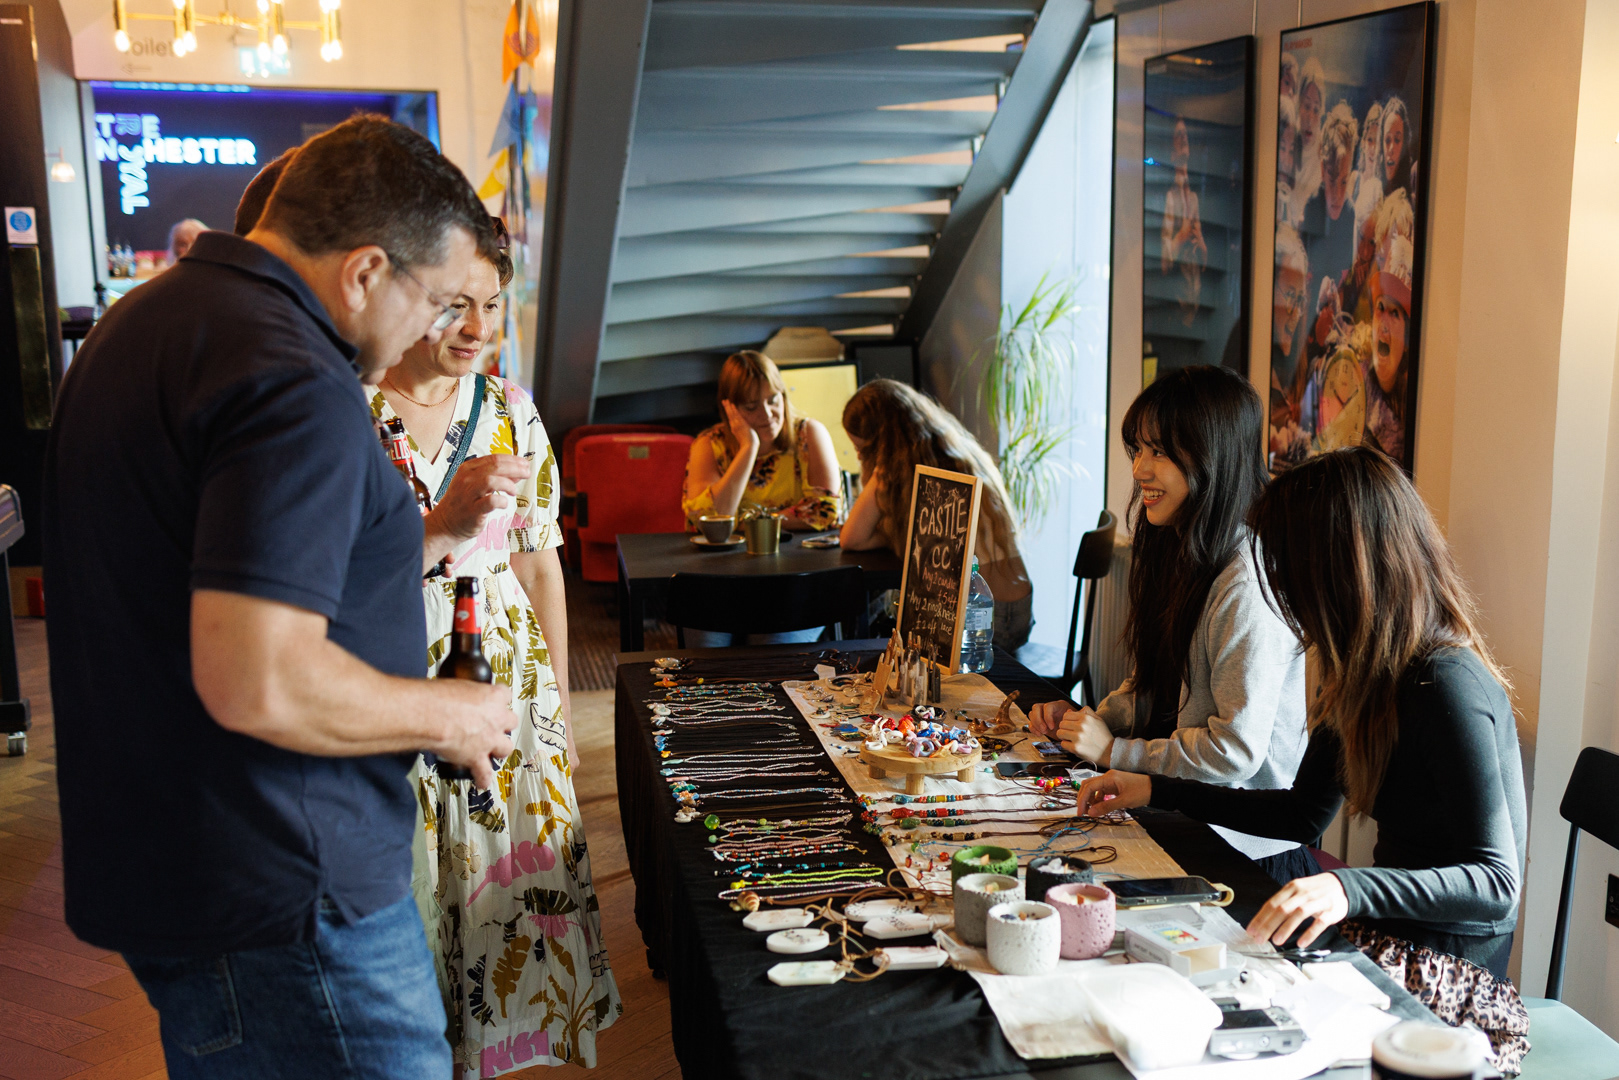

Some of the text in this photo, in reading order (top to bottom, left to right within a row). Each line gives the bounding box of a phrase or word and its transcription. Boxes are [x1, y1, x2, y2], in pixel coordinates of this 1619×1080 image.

[919, 498, 967, 539] CASTLE
[932, 545, 951, 570] CC
[909, 590, 922, 611] Any
